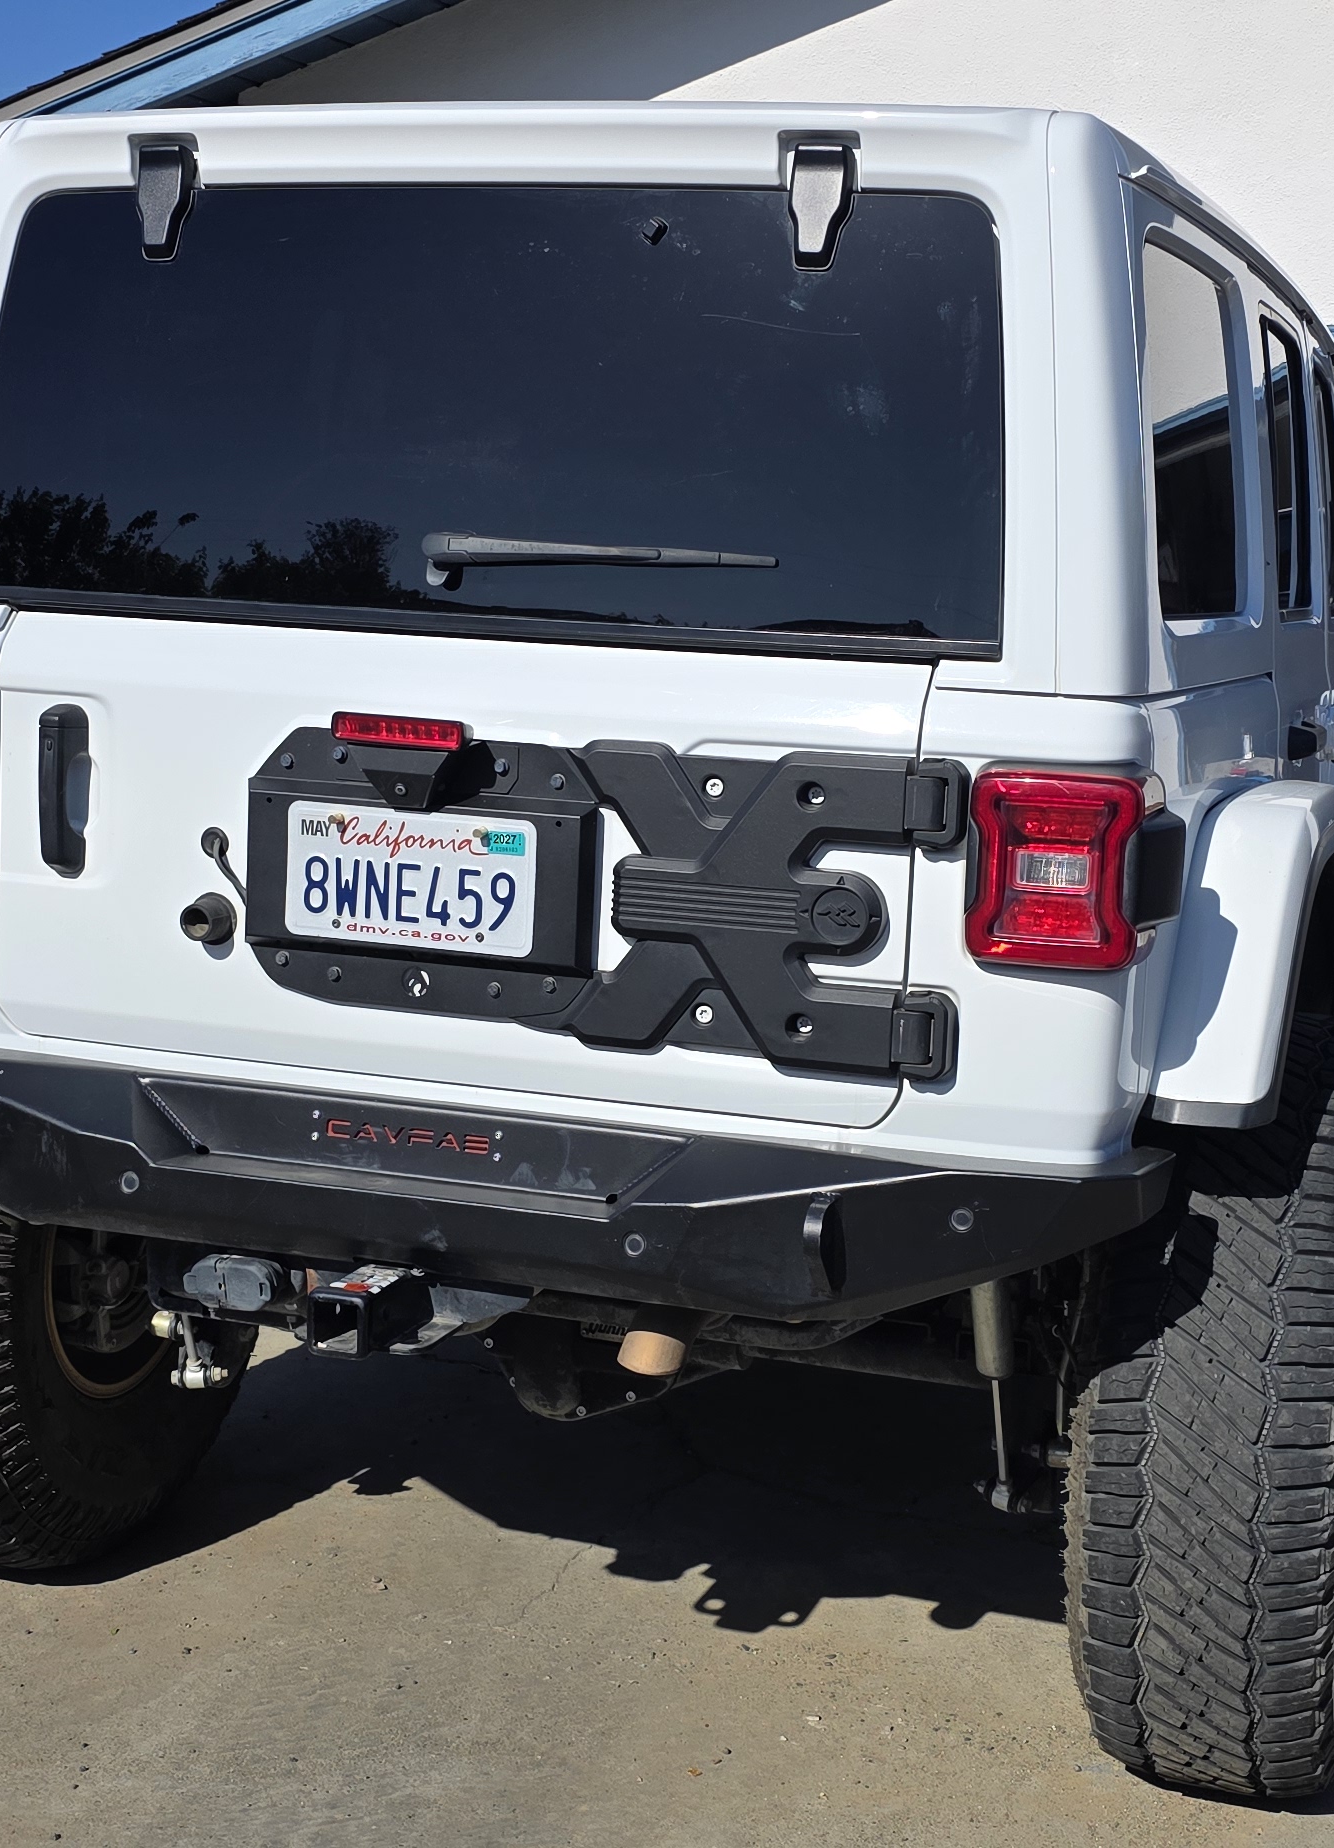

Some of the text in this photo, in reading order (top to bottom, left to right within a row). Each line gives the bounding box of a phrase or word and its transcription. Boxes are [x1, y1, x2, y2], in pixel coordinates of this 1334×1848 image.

[300, 818, 332, 838] MAY
[338, 816, 490, 859] California
[492, 833, 518, 845] 2027
[303, 855, 517, 932] 8WNE459
[345, 921, 471, 943] dmv.ca.gov
